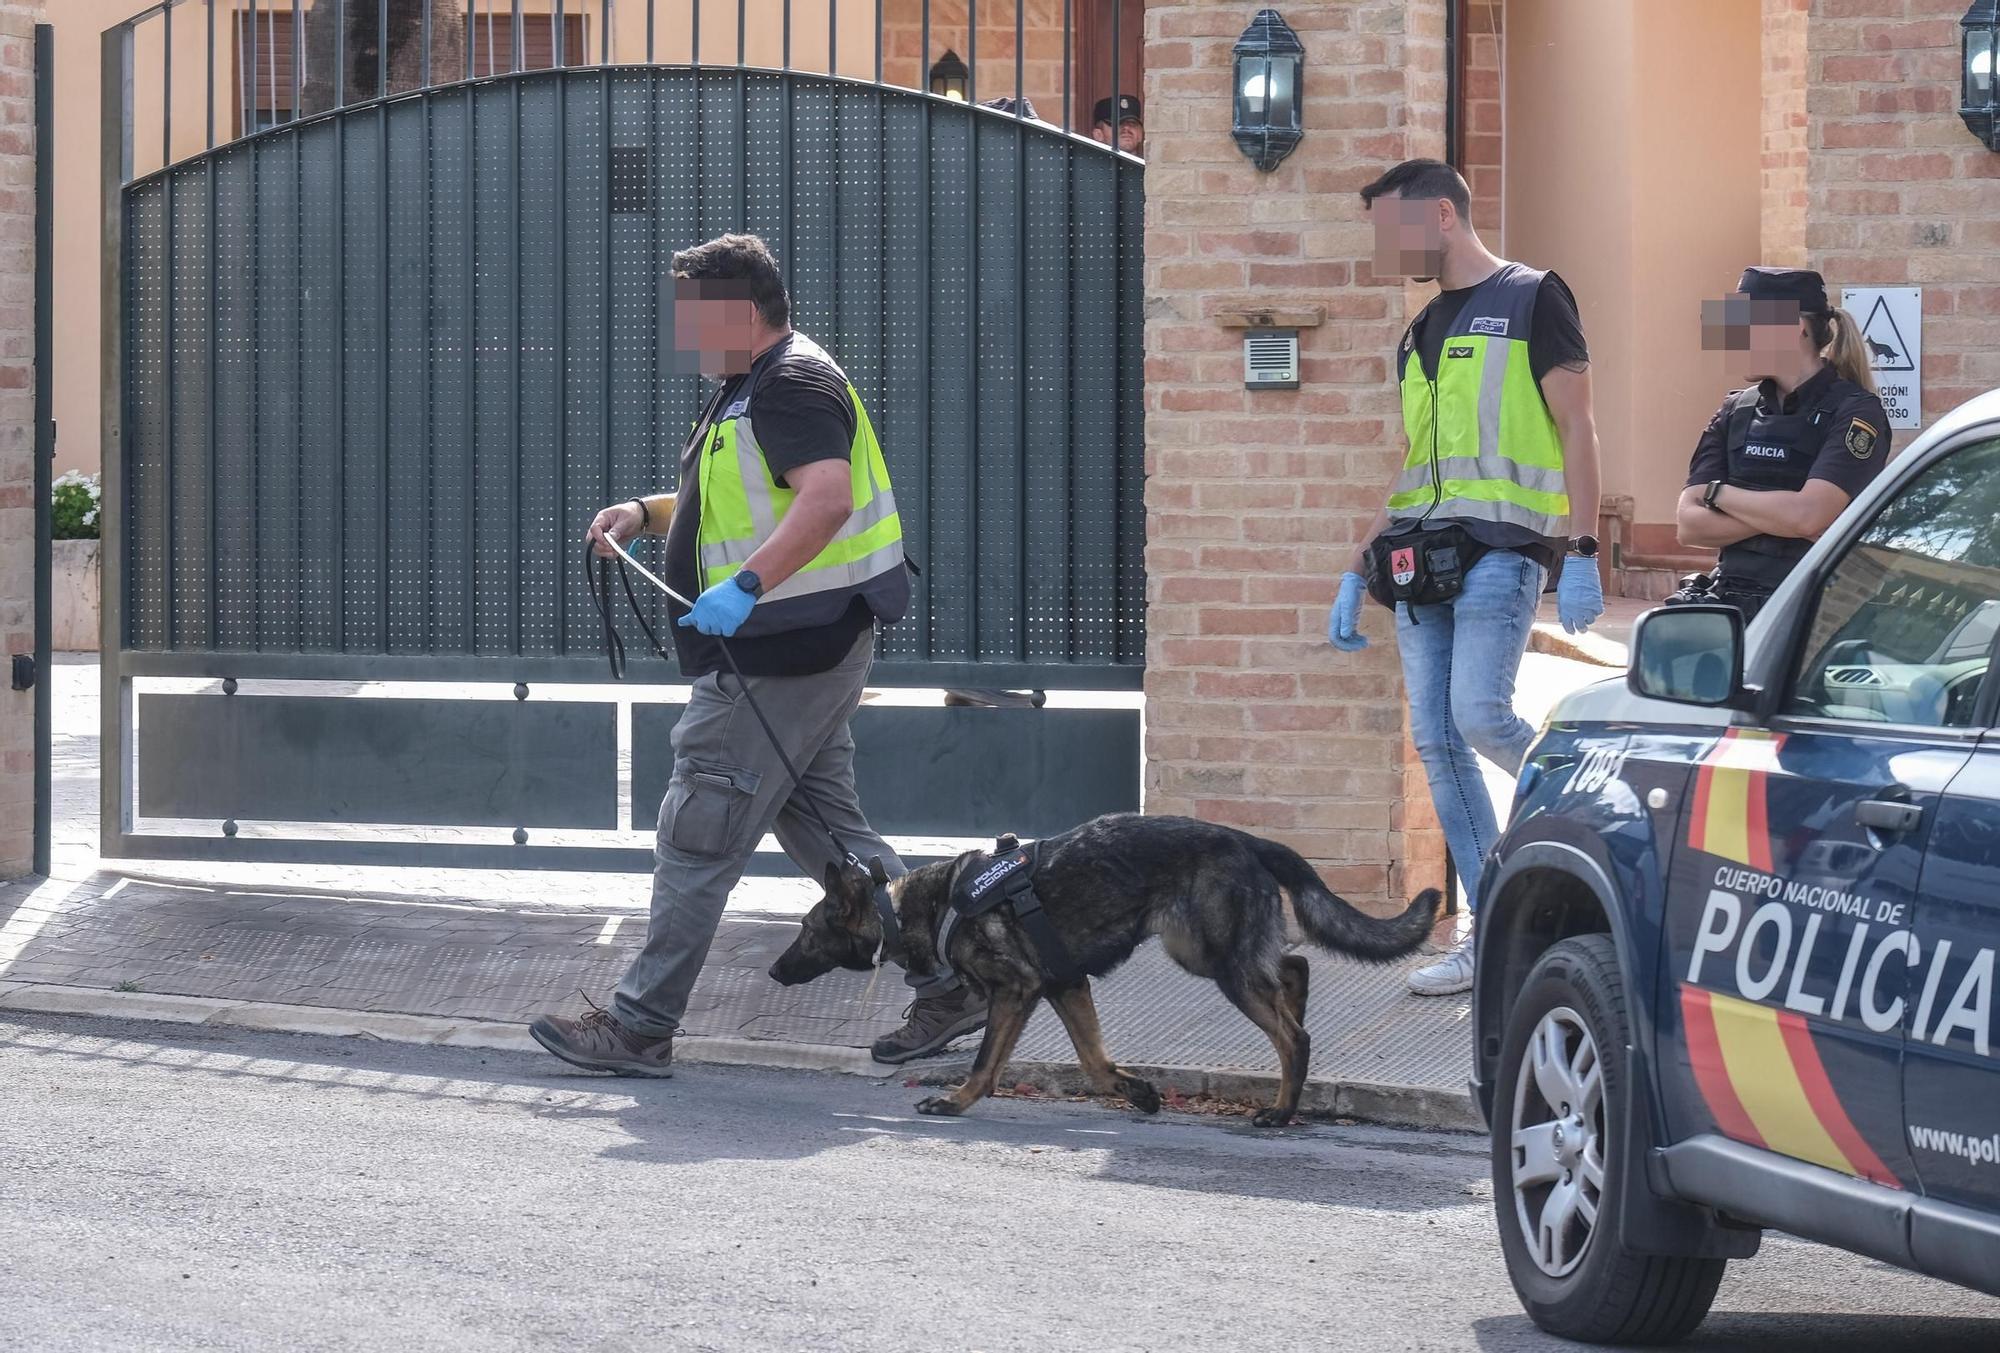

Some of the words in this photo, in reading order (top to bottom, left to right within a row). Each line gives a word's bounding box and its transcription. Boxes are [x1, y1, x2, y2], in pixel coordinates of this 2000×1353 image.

[1745, 445, 1785, 459] POLICIA
[971, 860, 1022, 898] NACIONAL
[974, 860, 1009, 886] POLICIA
[1714, 866, 1782, 899] CUERPO
[1783, 881, 1871, 919] NACIONAL
[1875, 900, 1906, 925] DE
[1686, 889, 1996, 1056] POLICIA
